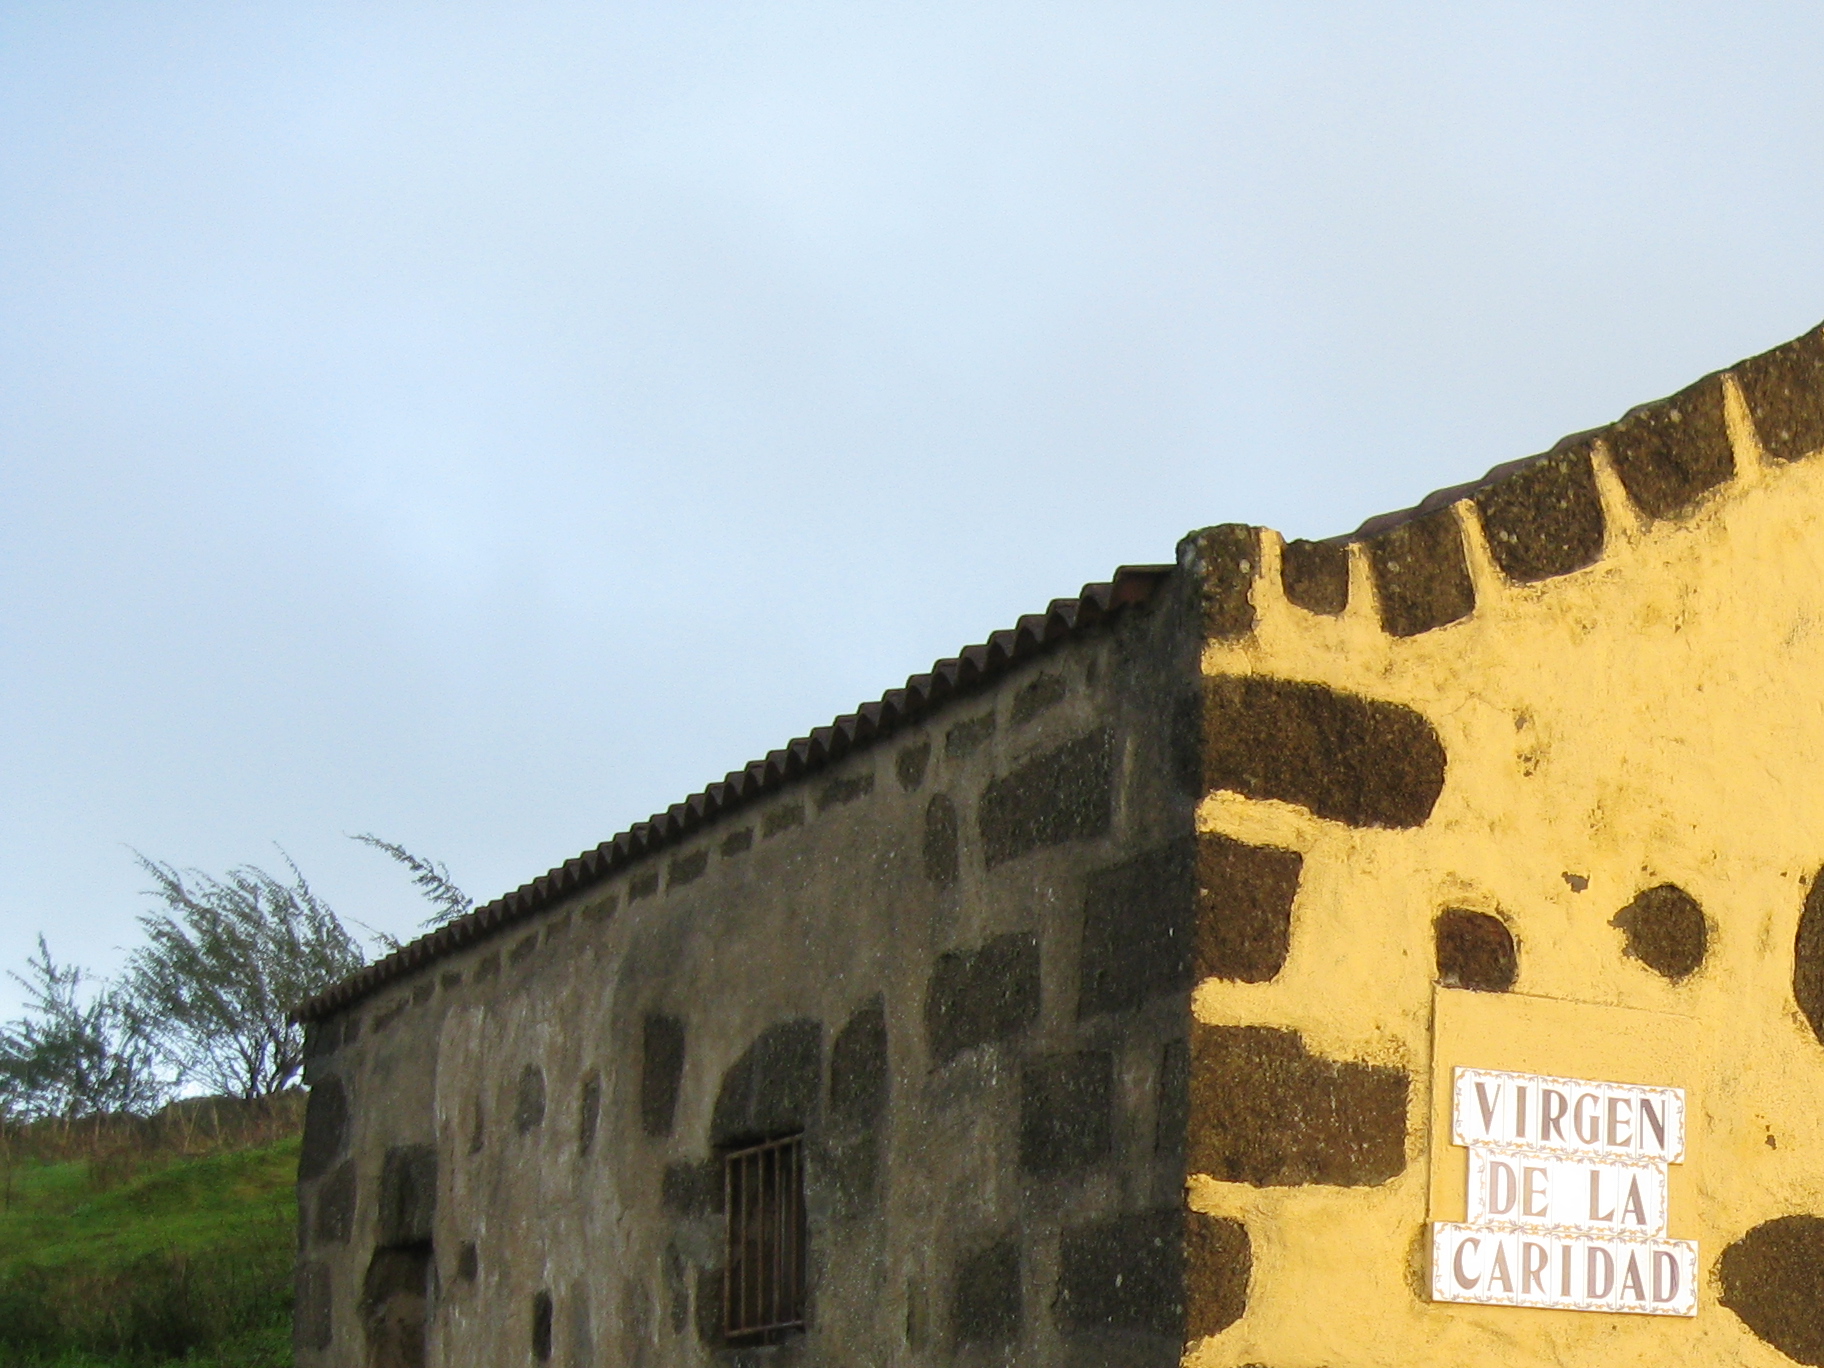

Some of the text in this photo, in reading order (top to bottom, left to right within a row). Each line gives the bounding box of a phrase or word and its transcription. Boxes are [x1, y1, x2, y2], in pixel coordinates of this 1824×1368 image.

[1474, 1081, 1666, 1151] VIRGEN
[1488, 1161, 1647, 1226] DE LA
[1453, 1236, 1680, 1303] CARIDAD
